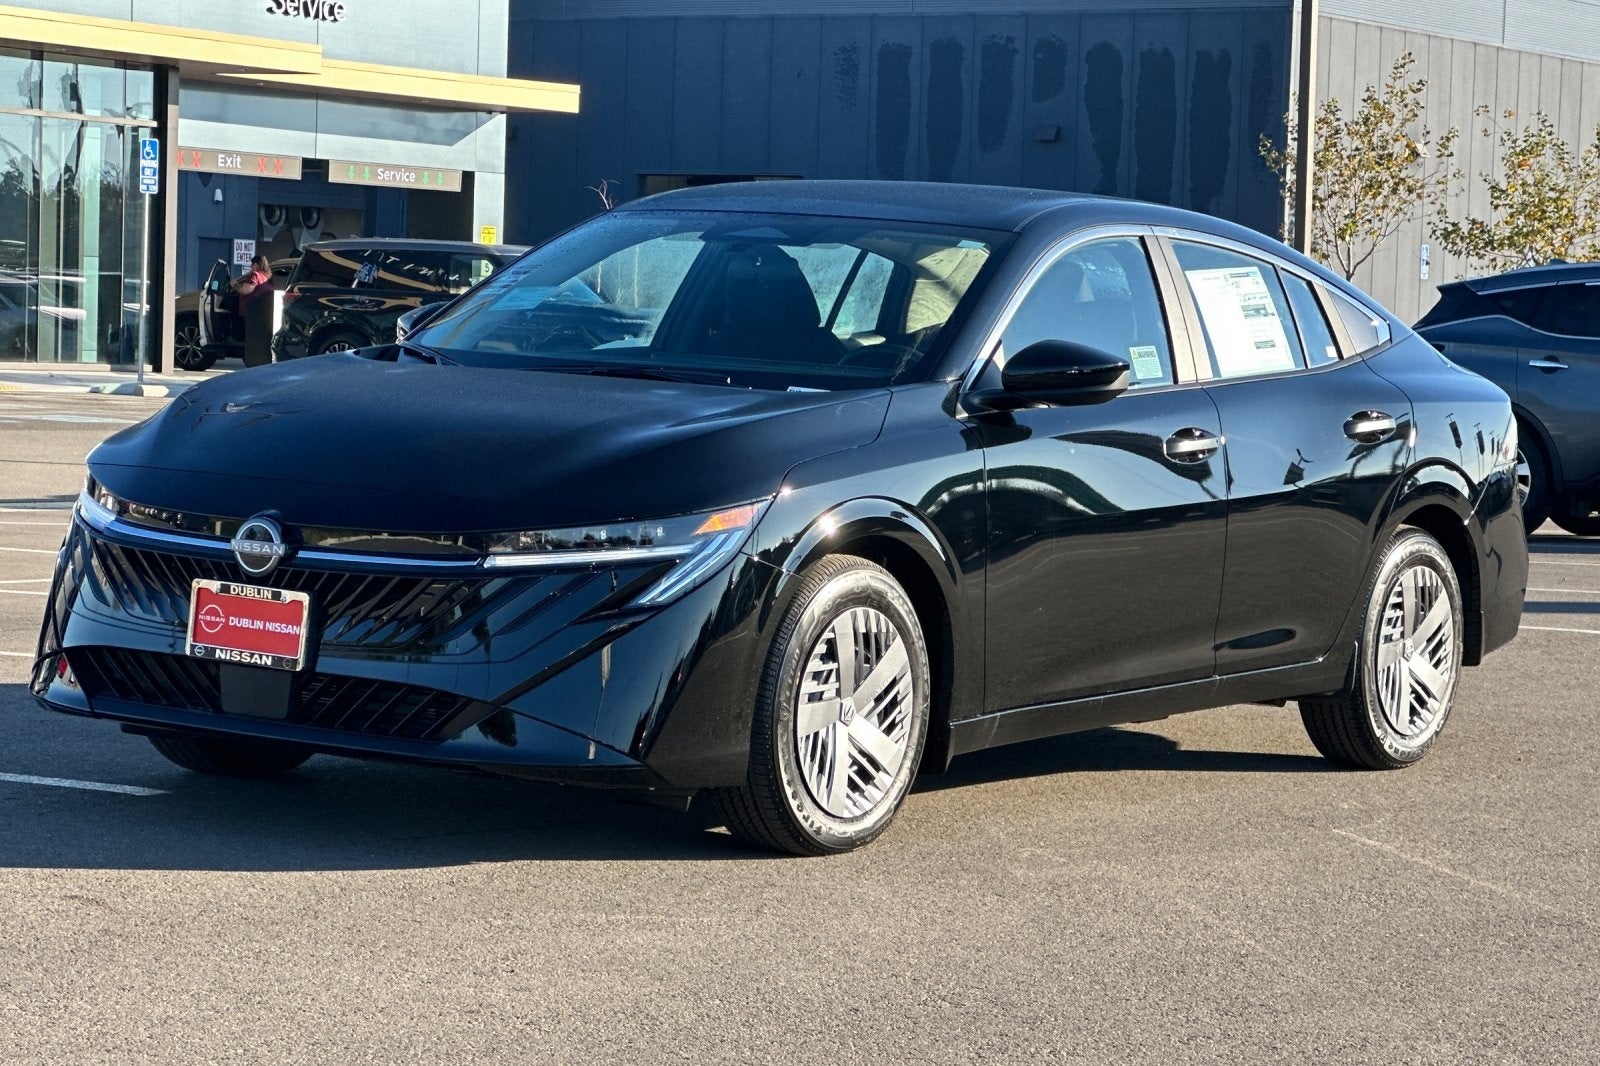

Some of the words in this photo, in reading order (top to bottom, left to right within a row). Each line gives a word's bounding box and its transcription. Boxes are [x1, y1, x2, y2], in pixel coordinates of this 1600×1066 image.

[217, 153, 242, 168] Exit
[377, 168, 416, 182] Service
[235, 241, 243, 251] DO
[243, 242, 254, 252] NOT
[236, 252, 252, 262] ENTER
[231, 540, 284, 554] NISSAN
[230, 585, 272, 599] DUBLIN
[198, 613, 226, 623] NISSAN
[228, 616, 264, 630] DUBLIN
[265, 623, 301, 636] NISSAN
[215, 649, 273, 666] NISSAN
